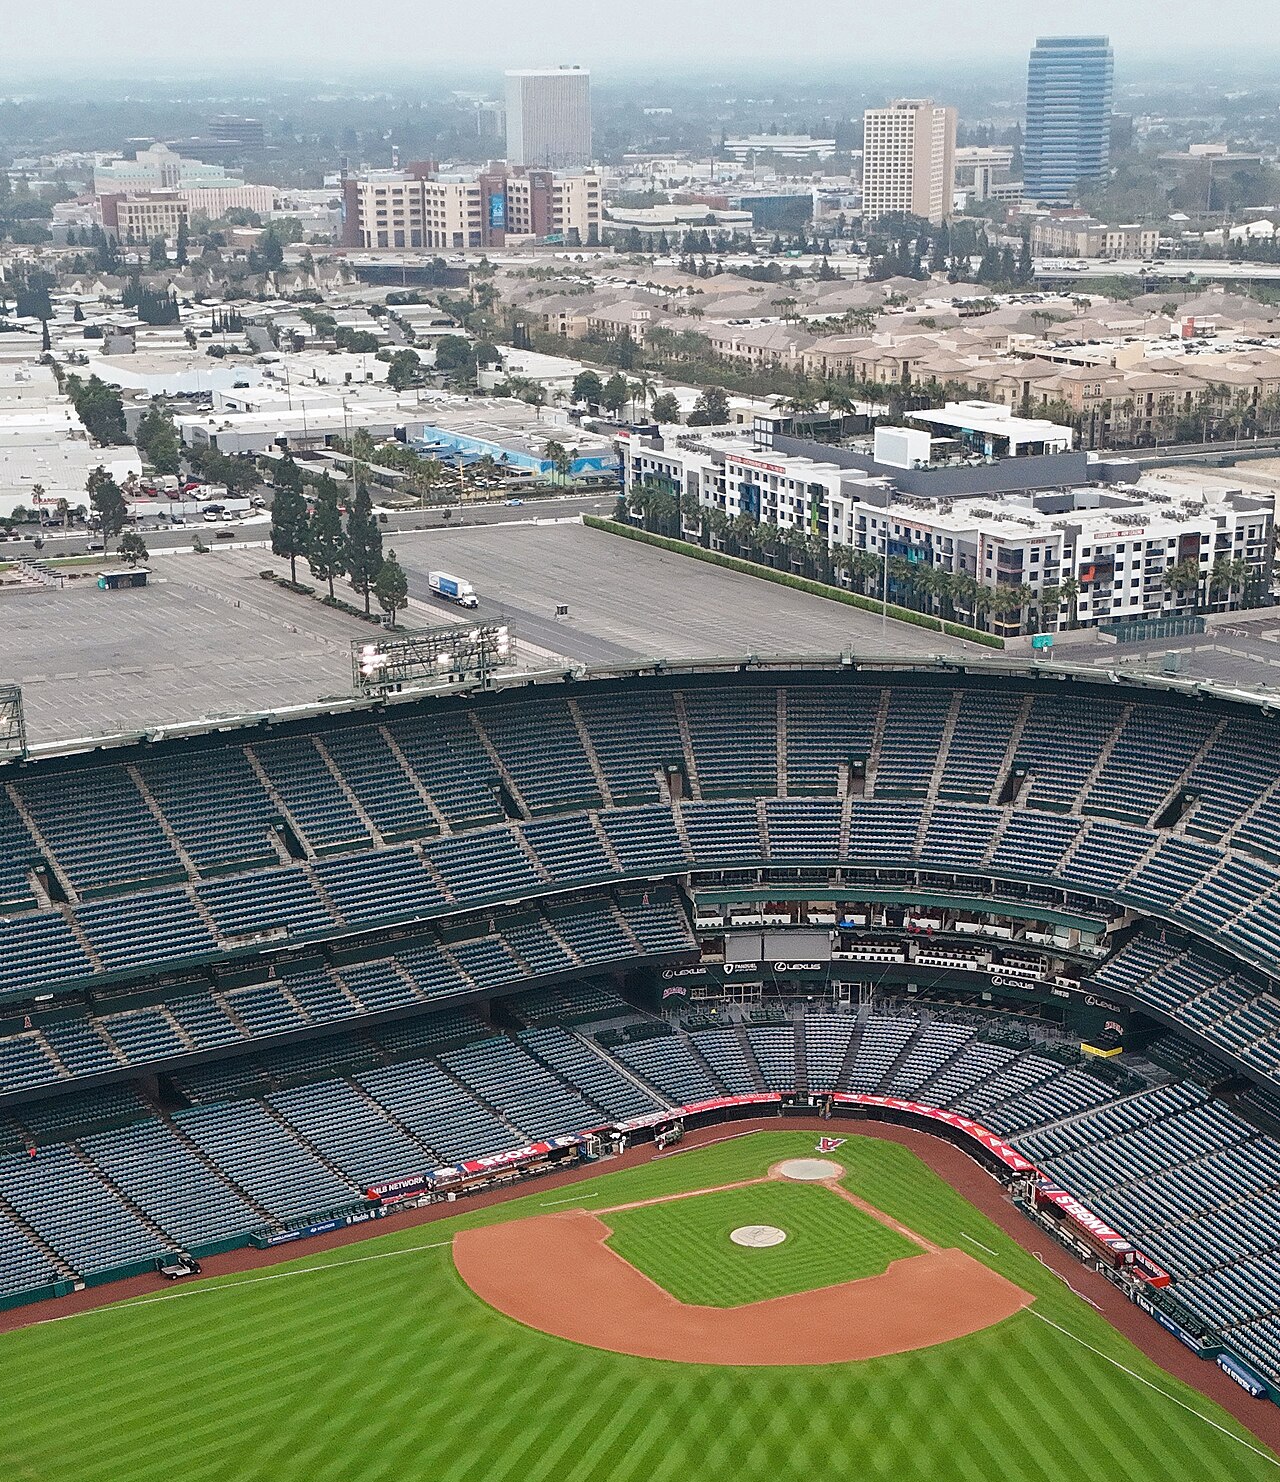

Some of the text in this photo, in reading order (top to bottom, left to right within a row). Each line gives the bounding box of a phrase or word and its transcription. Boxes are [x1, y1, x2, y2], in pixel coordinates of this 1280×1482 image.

[674, 967, 707, 977] LEXUS
[785, 962, 821, 971] LEXUS
[1002, 979, 1035, 990] LEXUS
[1094, 1001, 1121, 1012] LEXUS
[388, 1176, 424, 1192] NETWORK
[1055, 1196, 1116, 1235] ANGELS
